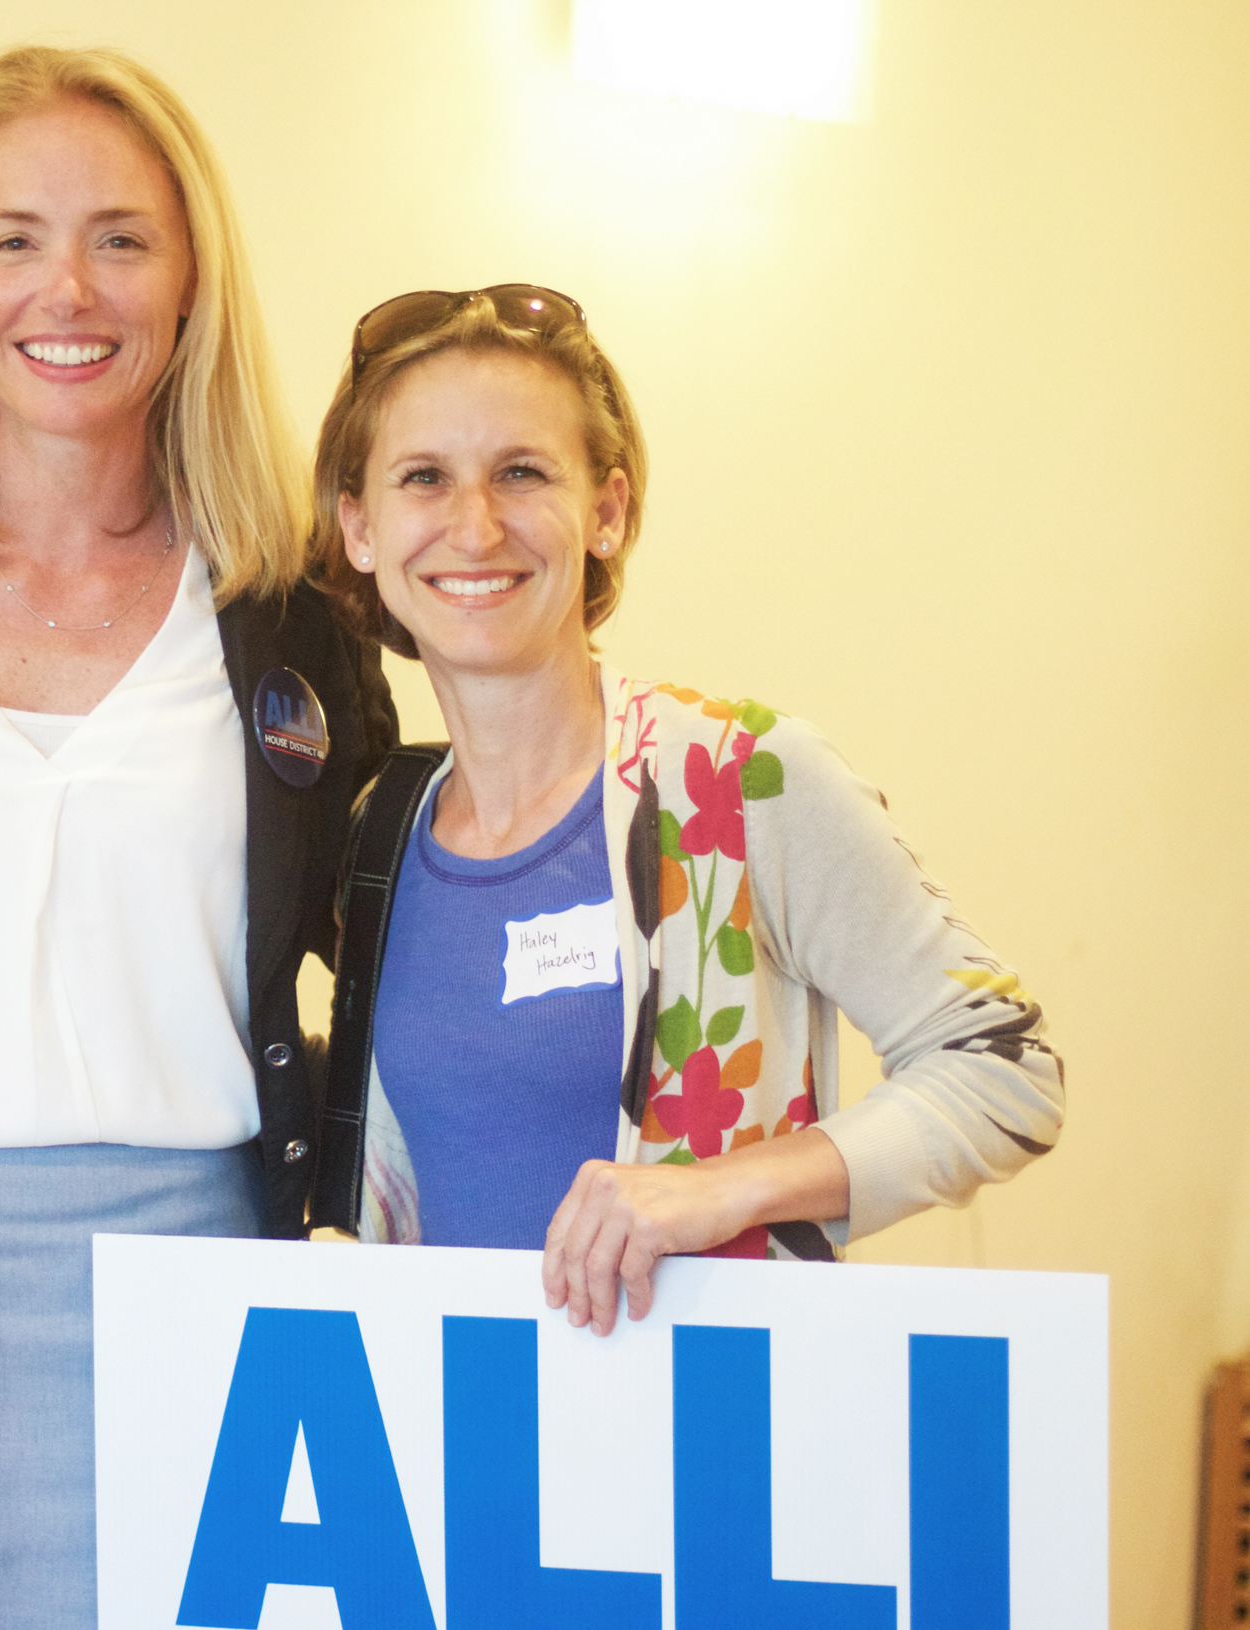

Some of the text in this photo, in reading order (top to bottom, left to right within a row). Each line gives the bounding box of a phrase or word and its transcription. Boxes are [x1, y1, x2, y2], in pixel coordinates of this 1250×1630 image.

[265, 690, 324, 742] ALLI
[265, 734, 288, 749] HOUSE
[289, 741, 317, 757] DISTRICT
[520, 930, 557, 952] Haley
[536, 946, 596, 976] Hazelrig
[176, 1306, 1010, 1630] ALLI
